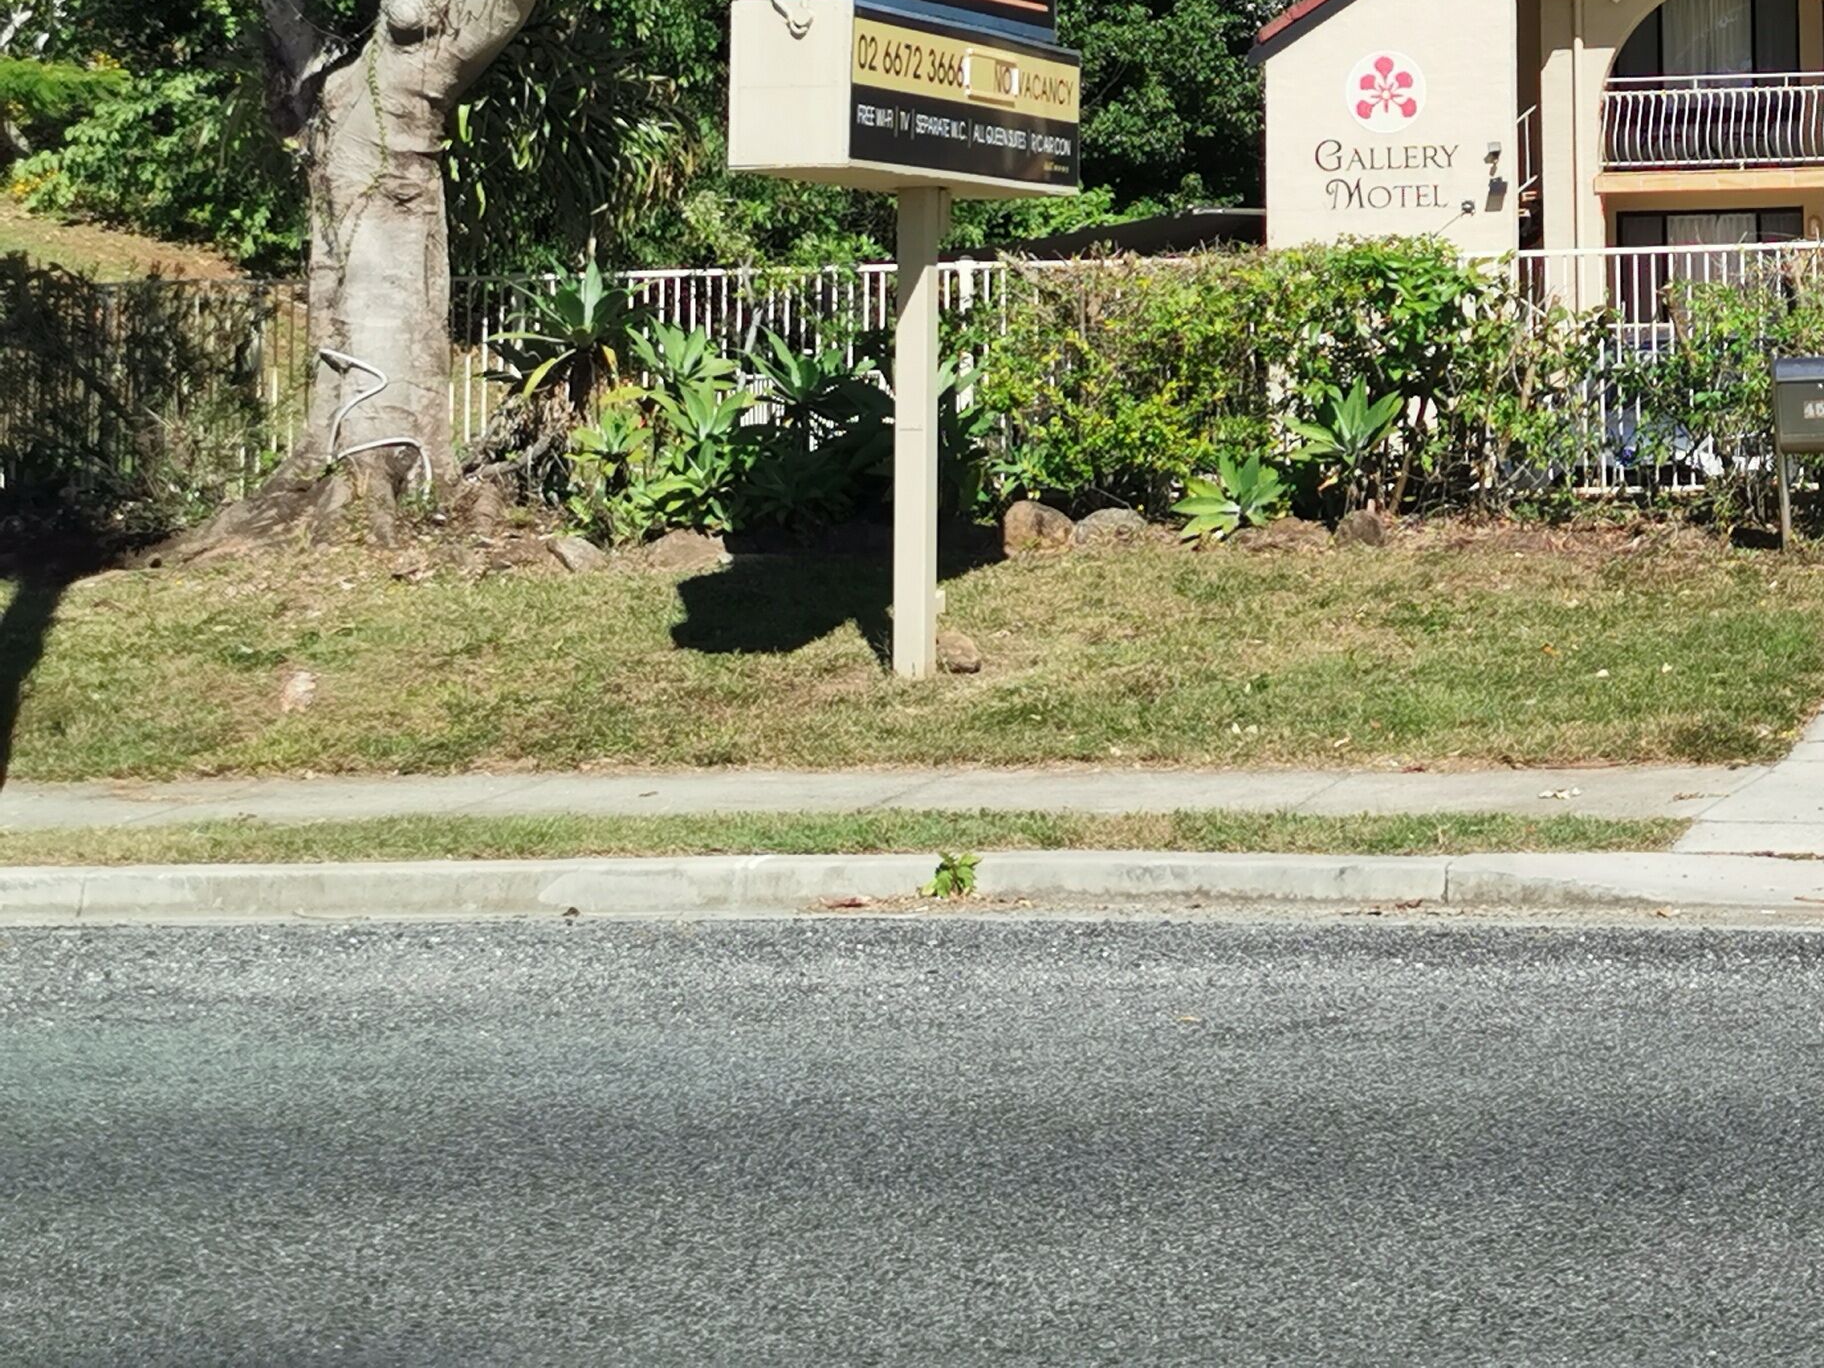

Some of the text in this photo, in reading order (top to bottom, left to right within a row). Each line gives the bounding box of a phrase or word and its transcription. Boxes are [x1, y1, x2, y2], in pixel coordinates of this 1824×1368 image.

[858, 34, 964, 88] 02 6672 3666
[994, 60, 1073, 106] NO VACANCY
[857, 104, 875, 126] FREE
[900, 111, 910, 131] TV
[916, 114, 950, 138] SEPARATE
[973, 124, 985, 144] ALL
[1314, 139, 1459, 172] GALLERY
[1325, 177, 1449, 211] MOTEL
